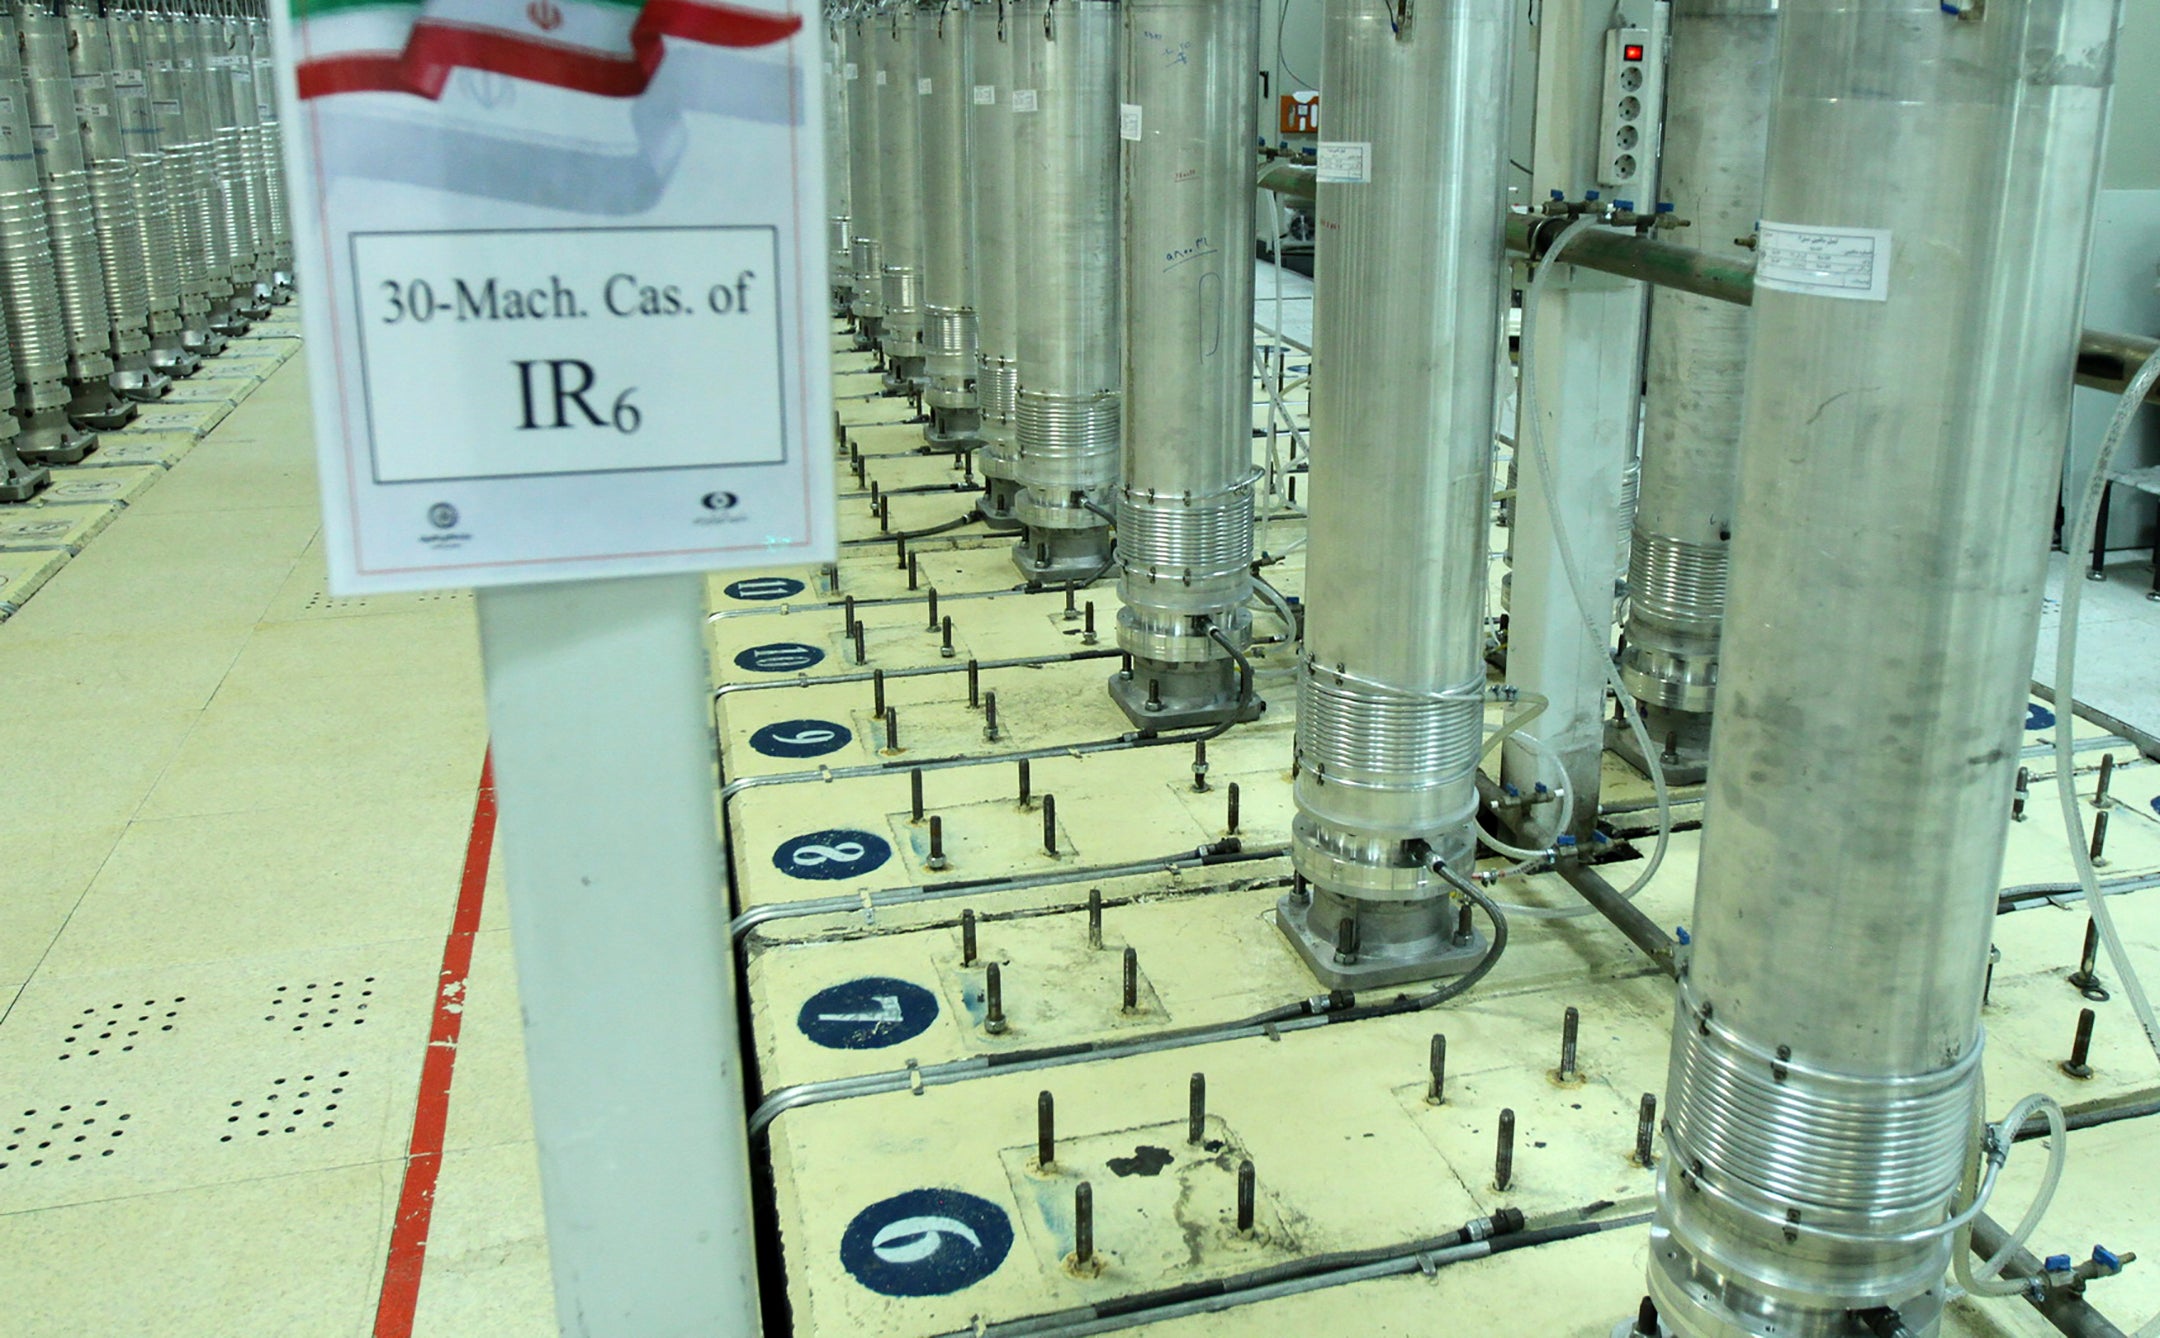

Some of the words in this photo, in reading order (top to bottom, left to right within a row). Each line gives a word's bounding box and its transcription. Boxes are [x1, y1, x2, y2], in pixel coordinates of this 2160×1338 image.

[379, 277, 590, 323] 30-Mach.
[603, 274, 694, 317] Cas.
[708, 271, 756, 314] of
[512, 359, 642, 434] IR6
[738, 580, 788, 598] 11
[754, 647, 811, 668] 10
[772, 729, 835, 745] 9
[793, 841, 865, 866] 8
[873, 1216, 982, 1263] 6
